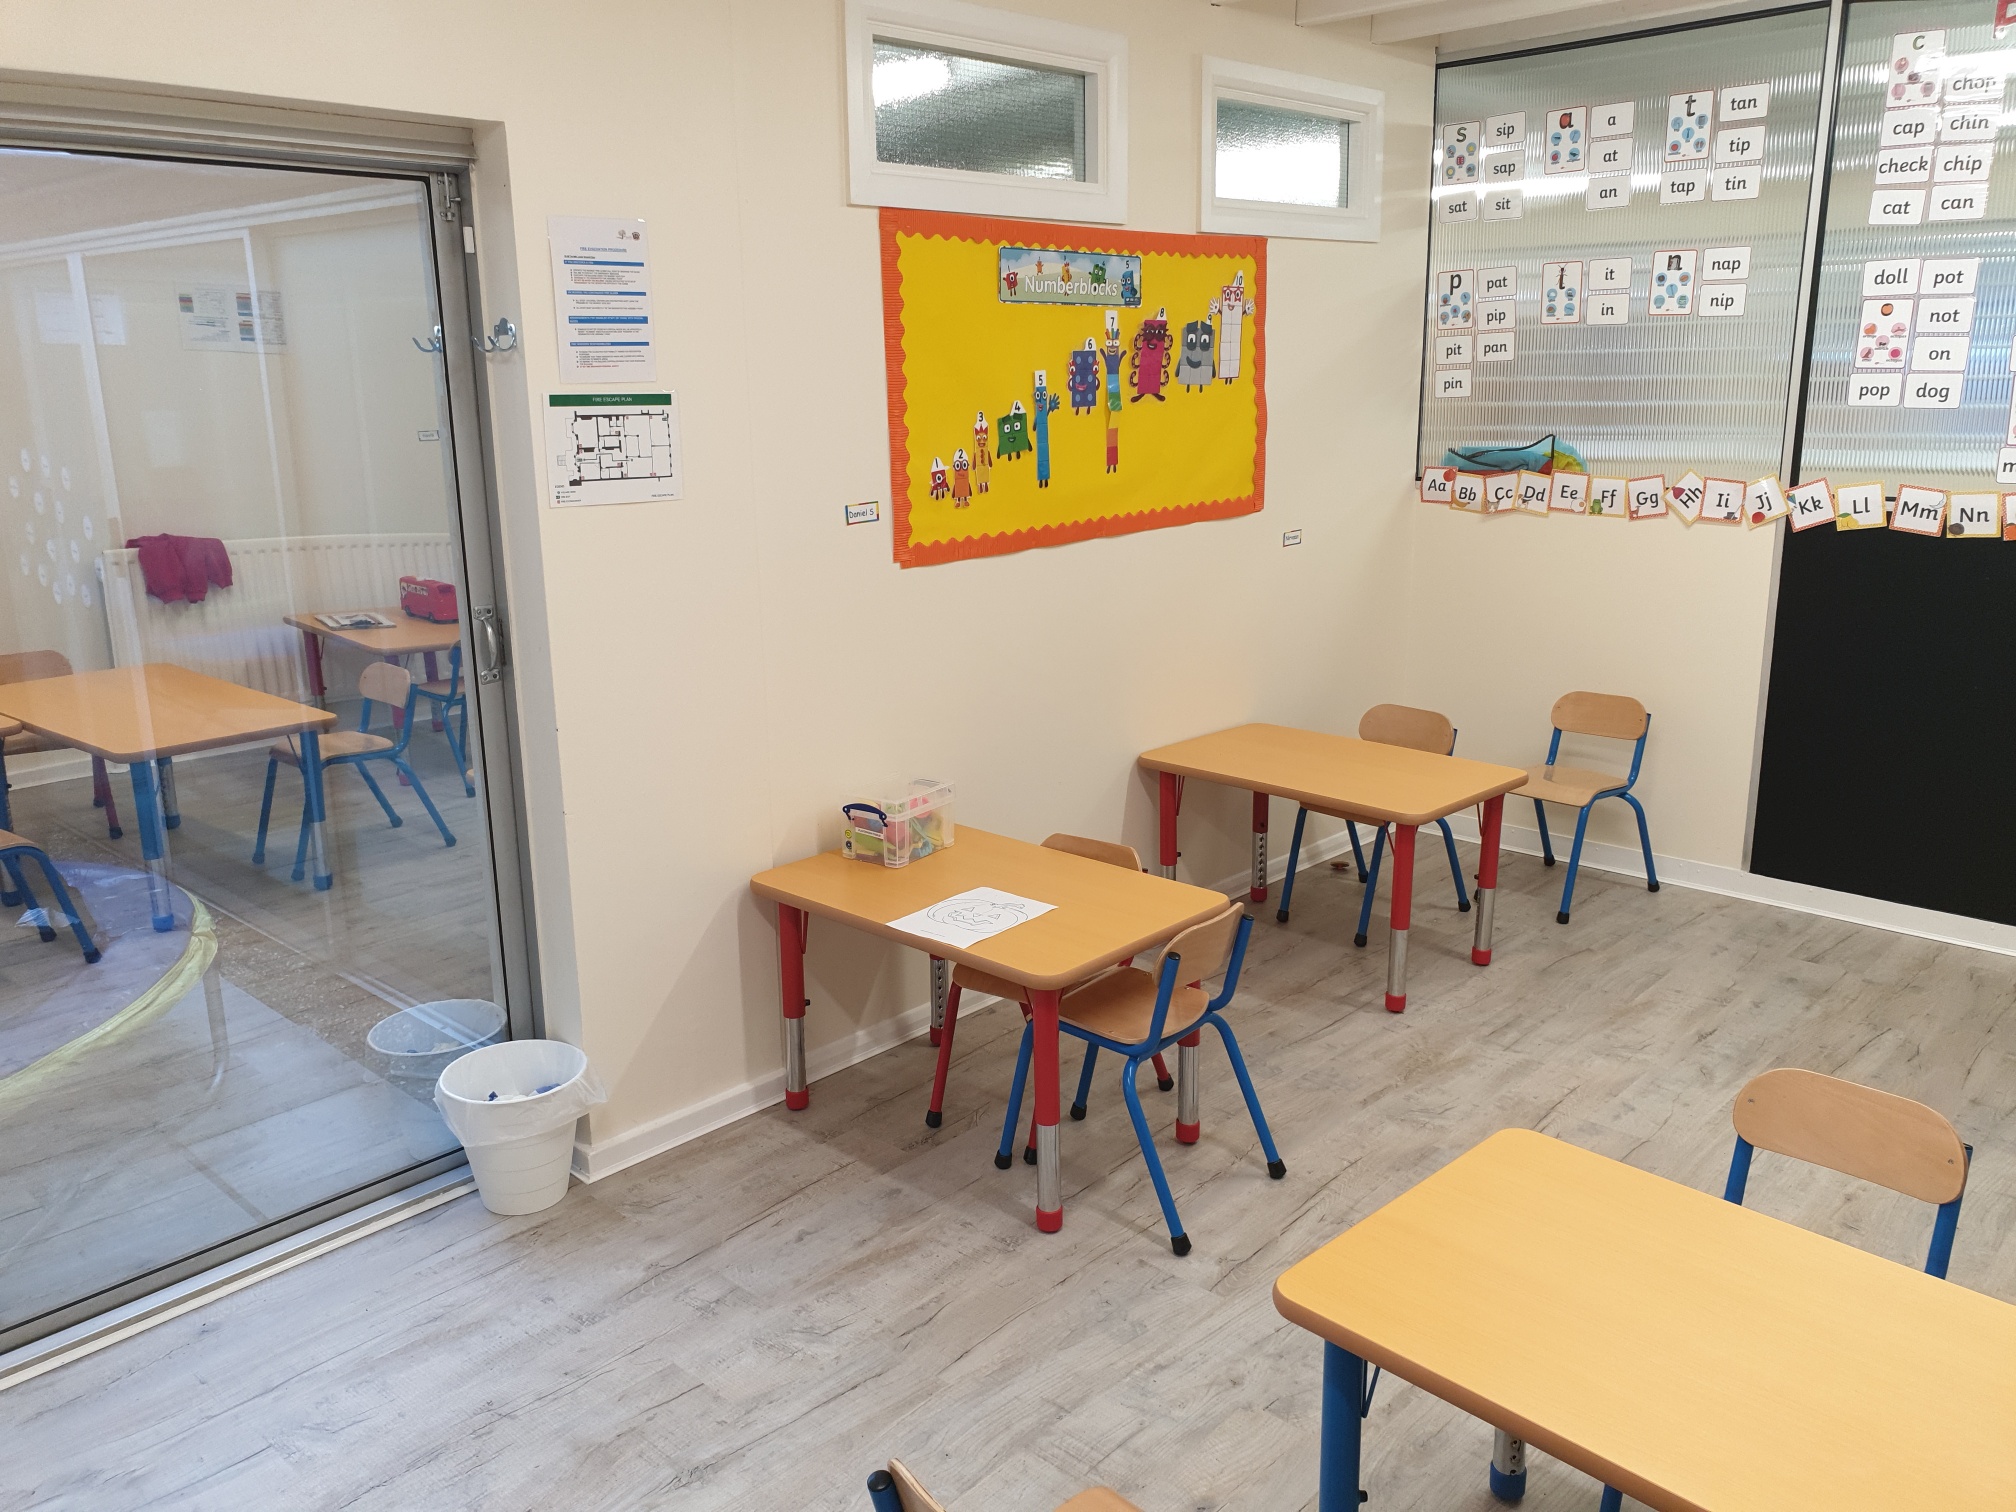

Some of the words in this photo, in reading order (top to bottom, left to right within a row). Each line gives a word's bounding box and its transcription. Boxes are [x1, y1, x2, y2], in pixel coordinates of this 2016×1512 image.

[1912, 34, 1926, 51] c
[1684, 94, 1698, 118] t
[1730, 97, 1758, 111] tan
[1607, 115, 1617, 127] a
[1949, 114, 1989, 131] chin
[1455, 126, 1468, 143] s
[1496, 122, 1515, 139] sip
[1892, 122, 1925, 139] cap
[1729, 137, 1751, 156] tip
[1603, 149, 1619, 163] at
[1493, 162, 1516, 177] sap
[1877, 155, 1929, 174] check
[1943, 154, 1983, 175] chip
[1670, 180, 1696, 197] tap
[1724, 175, 1747, 191] tin
[1599, 188, 1618, 199] an
[1448, 200, 1468, 214] sat
[1495, 197, 1512, 211] sit
[1882, 201, 1911, 215] cat
[1940, 197, 1974, 210] can
[1125, 260, 1130, 269] 5
[1667, 254, 1682, 271] n
[1711, 259, 1741, 274] nap
[1235, 275, 1243, 286] 10
[1604, 267, 1615, 281] it
[1874, 267, 1908, 286] doll
[1932, 270, 1965, 289] pot
[1025, 275, 1118, 296] Numberblocks
[1449, 273, 1462, 296] p
[1486, 276, 1508, 293] pat
[1601, 302, 1615, 316] in
[1710, 292, 1735, 311] nip
[1159, 308, 1165, 317] 8
[1207, 314, 1212, 324] 9
[1486, 308, 1506, 326] pip
[1929, 309, 1960, 323] not
[1110, 317, 1115, 327] 7
[1087, 338, 1093, 349] 6
[1446, 343, 1463, 360] pit
[1483, 343, 1508, 357] pan
[1928, 349, 1951, 361] on
[1038, 375, 1043, 385] 5
[1443, 376, 1463, 393] pin
[1858, 385, 1891, 401] pop
[1915, 382, 1950, 403] dog
[1014, 402, 1021, 412] 4
[978, 412, 984, 422] 3
[958, 449, 964, 459] 2
[1428, 478, 1447, 492] Aa
[1560, 485, 1578, 499] Ee
[1458, 487, 1477, 501] Bb
[1494, 487, 1514, 500] Cc
[1523, 486, 1546, 502] Dd
[1601, 490, 1617, 508] Ff
[1636, 491, 1659, 507] Gg
[1679, 487, 1701, 509] Hh
[1716, 493, 1731, 508] Ii
[1755, 491, 1773, 511] Jj
[849, 508, 868, 519] Daniel
[869, 508, 875, 516] S
[1799, 496, 1824, 515] Kk
[1852, 497, 1870, 514] Ll
[1900, 501, 1939, 521] Mm
[1959, 507, 1990, 523] Nn
